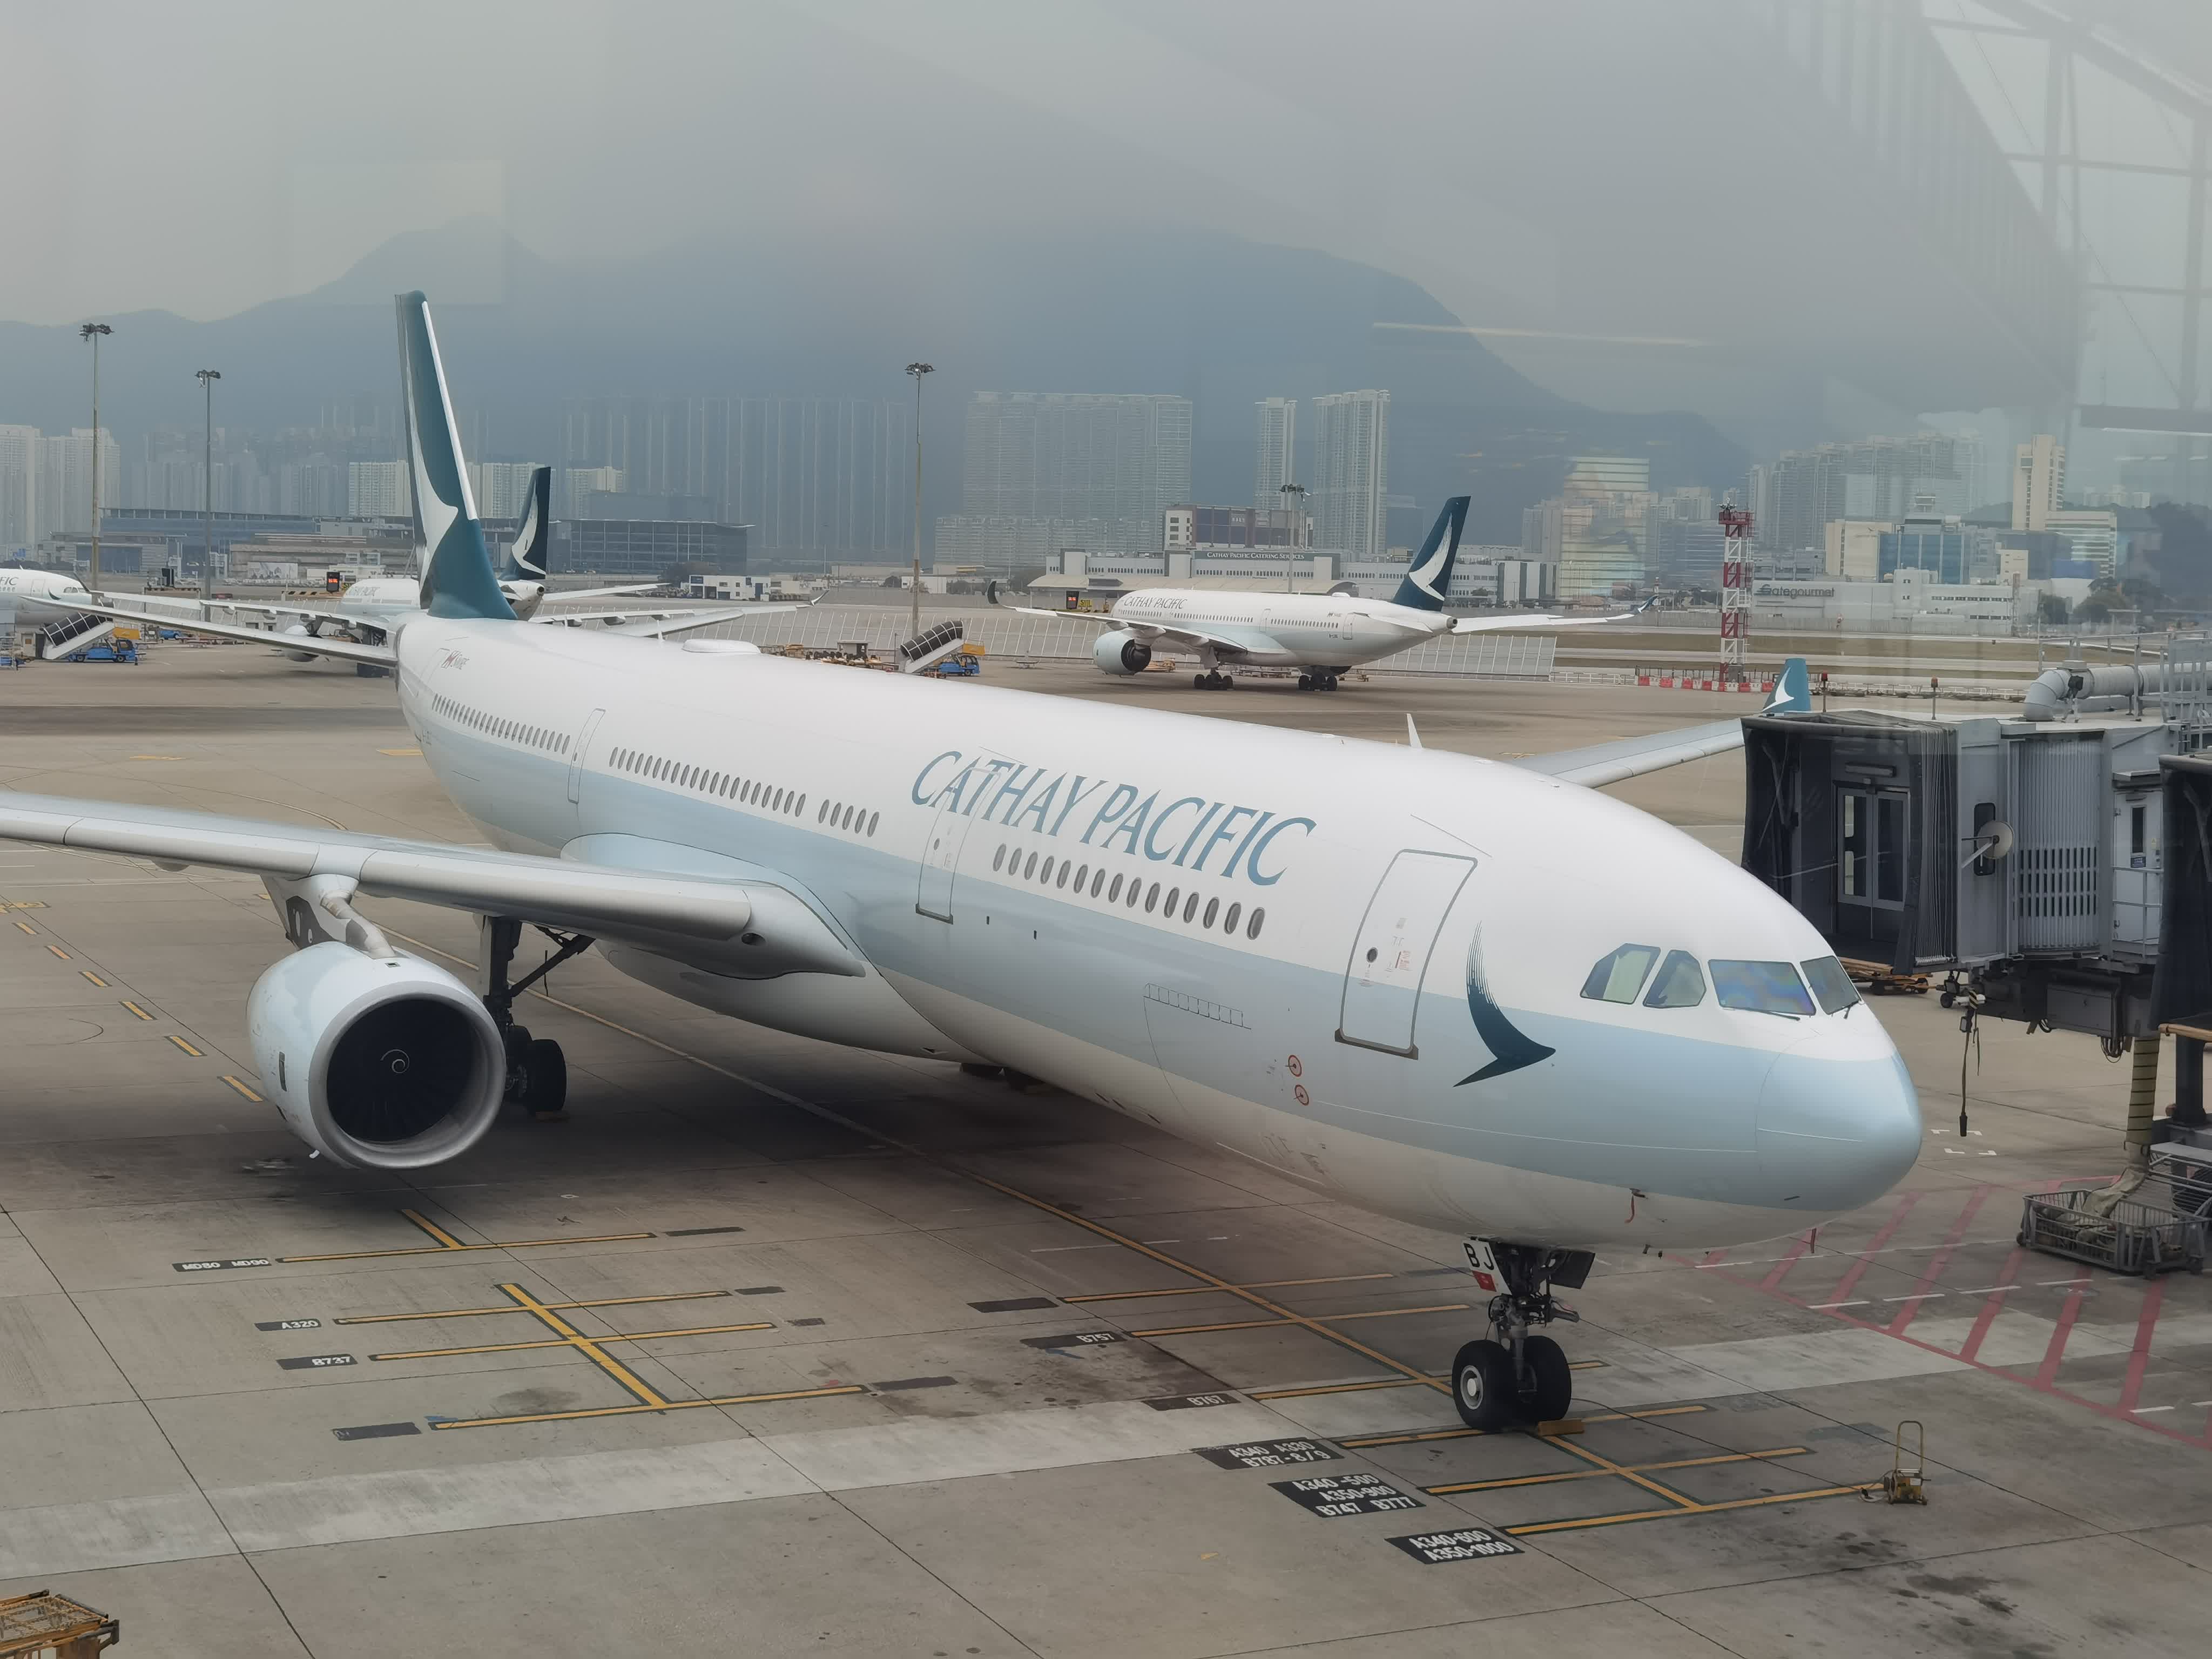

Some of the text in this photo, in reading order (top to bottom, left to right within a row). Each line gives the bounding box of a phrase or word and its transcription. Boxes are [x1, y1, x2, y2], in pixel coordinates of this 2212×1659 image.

[1124, 596, 1188, 609] CATHAY PACIFIC
[912, 751, 1317, 886] CATHAY PACIFIC
[1463, 1242, 1494, 1271] BJ
[182, 1262, 221, 1270] MD80
[281, 1320, 319, 1329] A320
[1076, 1333, 1115, 1343] B757
[312, 1356, 351, 1366] B737
[1186, 1395, 1226, 1406] B767
[1228, 1441, 1316, 1458] A340 A330
[1292, 1478, 1339, 1491] A340
[1319, 1485, 1397, 1502] A350-900
[1315, 1496, 1417, 1516] B747 B777
[1408, 1530, 1492, 1549] A340-600
[1423, 1541, 1514, 1561] A350-1000
